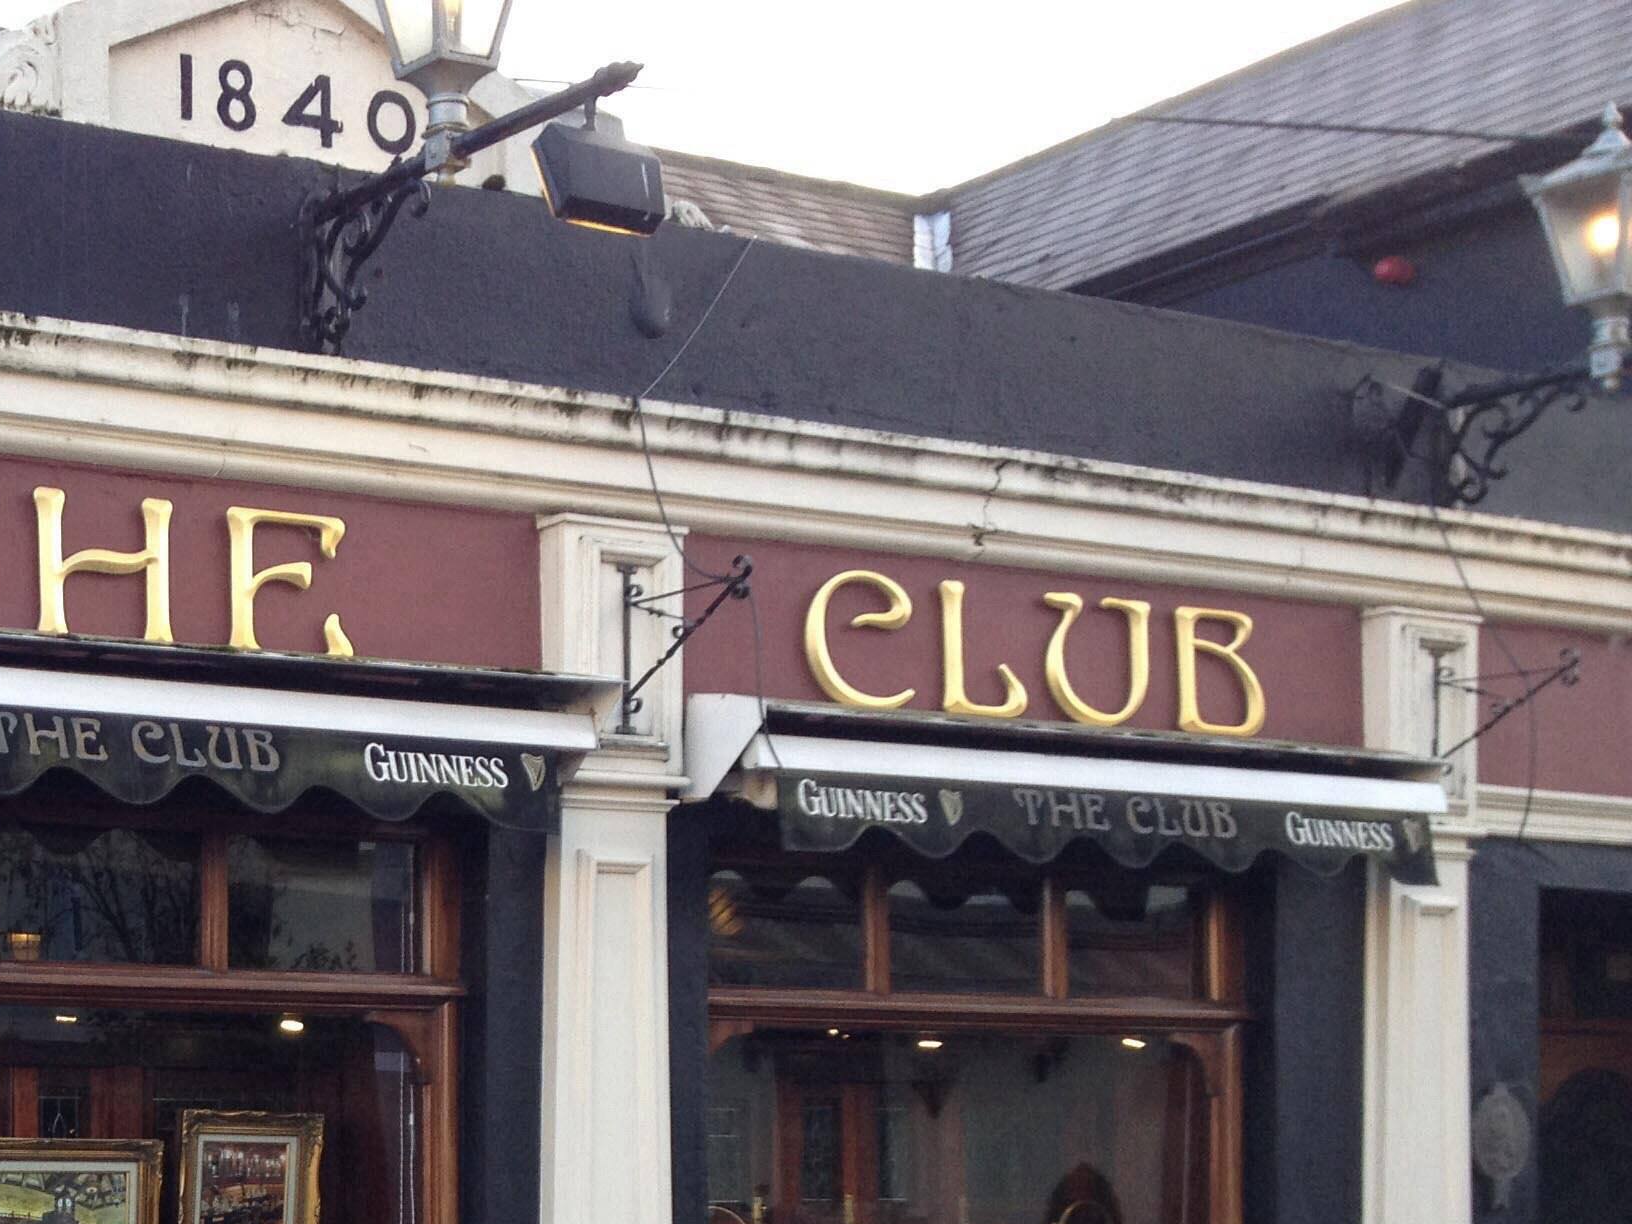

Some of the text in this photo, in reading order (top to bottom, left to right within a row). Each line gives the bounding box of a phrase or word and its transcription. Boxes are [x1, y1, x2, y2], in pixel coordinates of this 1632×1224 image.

[180, 53, 416, 155] 1840
[804, 569, 1265, 736] CLUB
[131, 721, 280, 773] CLUB
[364, 742, 509, 790] GUINNESS
[797, 776, 927, 826] GUINNESS
[1013, 788, 1238, 840] THE CLUB
[1284, 811, 1394, 853] GUINNESS
